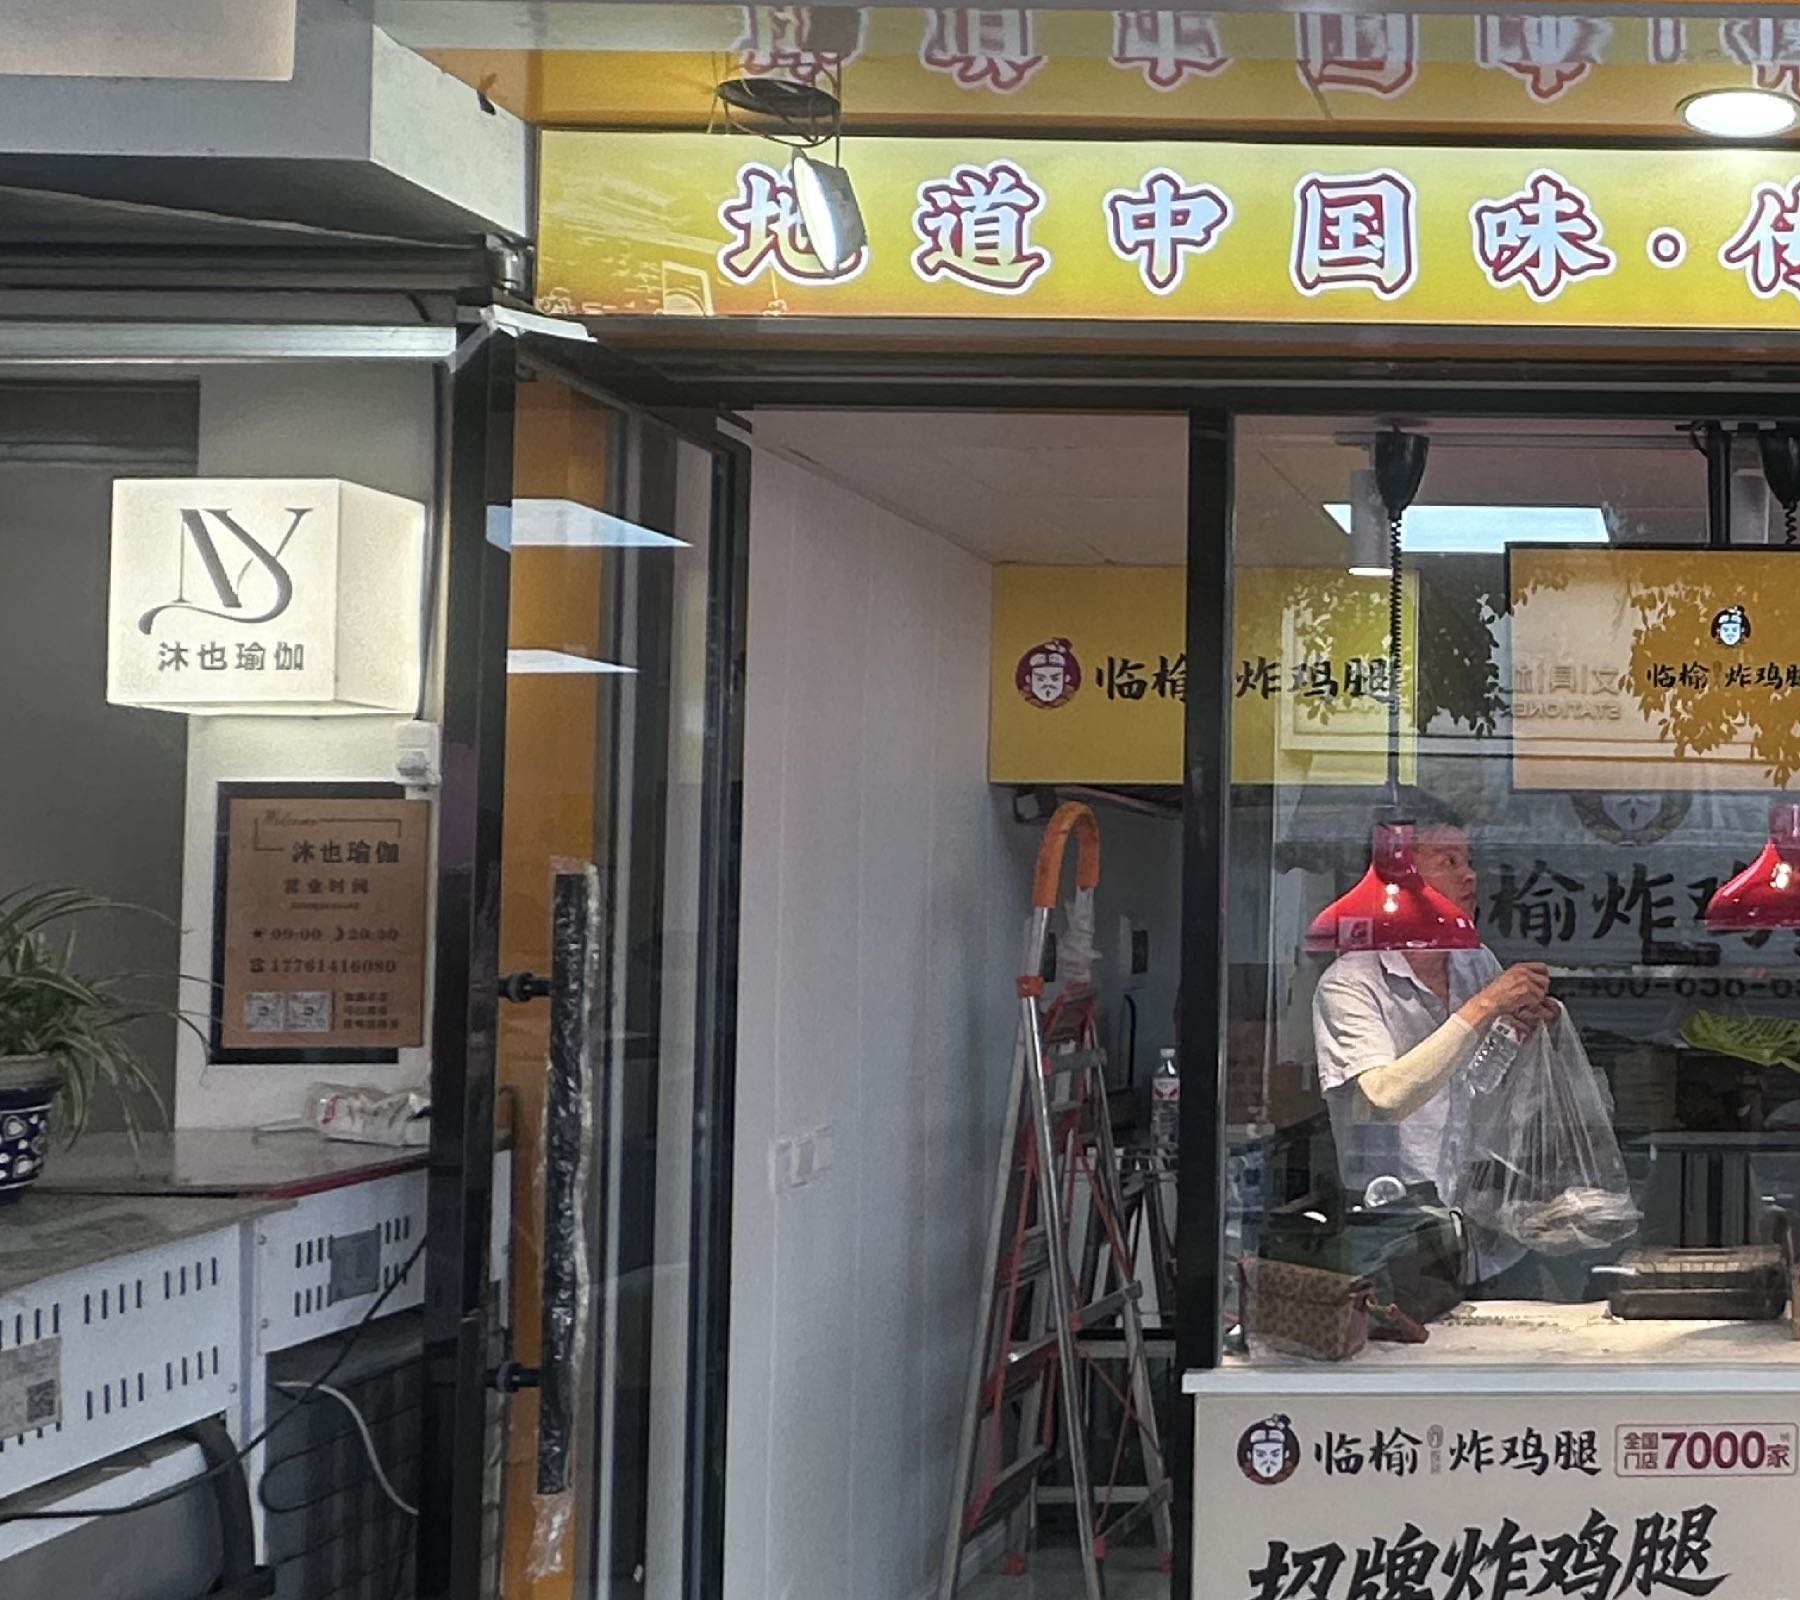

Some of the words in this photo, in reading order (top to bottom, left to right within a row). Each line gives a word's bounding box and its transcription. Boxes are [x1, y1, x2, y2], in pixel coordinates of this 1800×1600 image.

[158, 641, 305, 671] 沐也瑜伽
[291, 839, 400, 864] 沐也瑜伽
